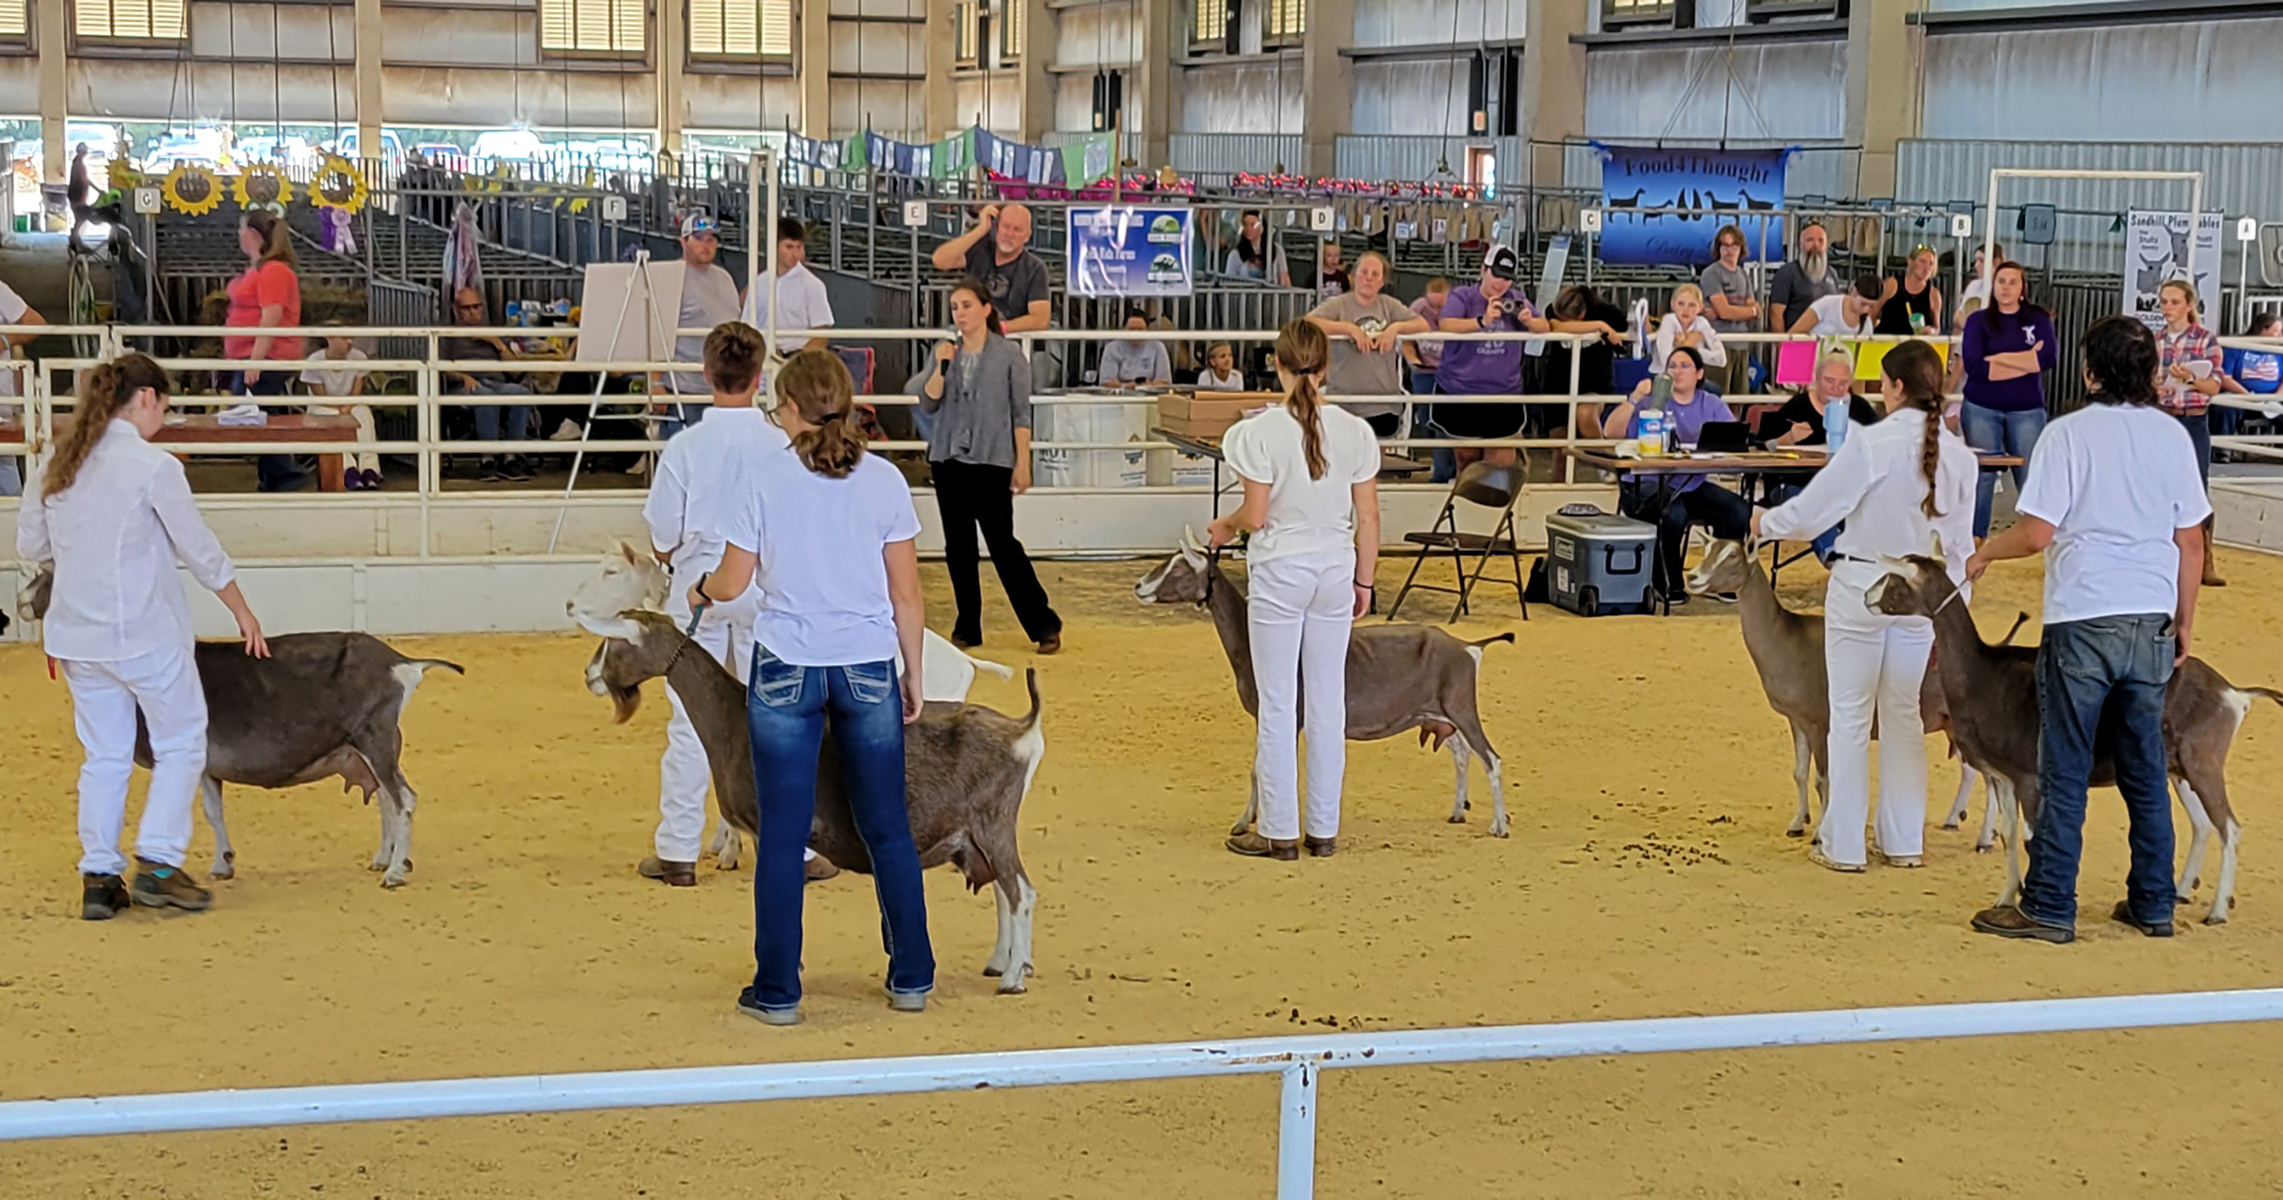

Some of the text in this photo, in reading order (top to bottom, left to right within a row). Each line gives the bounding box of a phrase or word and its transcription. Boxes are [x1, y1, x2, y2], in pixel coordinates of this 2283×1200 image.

[1624, 153, 1771, 185] Food4Thought
[142, 193, 151, 206] G
[610, 200, 620, 213] F
[911, 206, 919, 219] E
[1318, 212, 1326, 224] D
[1587, 213, 1595, 225] C
[1958, 219, 1965, 230] B
[2131, 214, 2220, 229] Sandhill Plum ables
[2243, 222, 2249, 233] A
